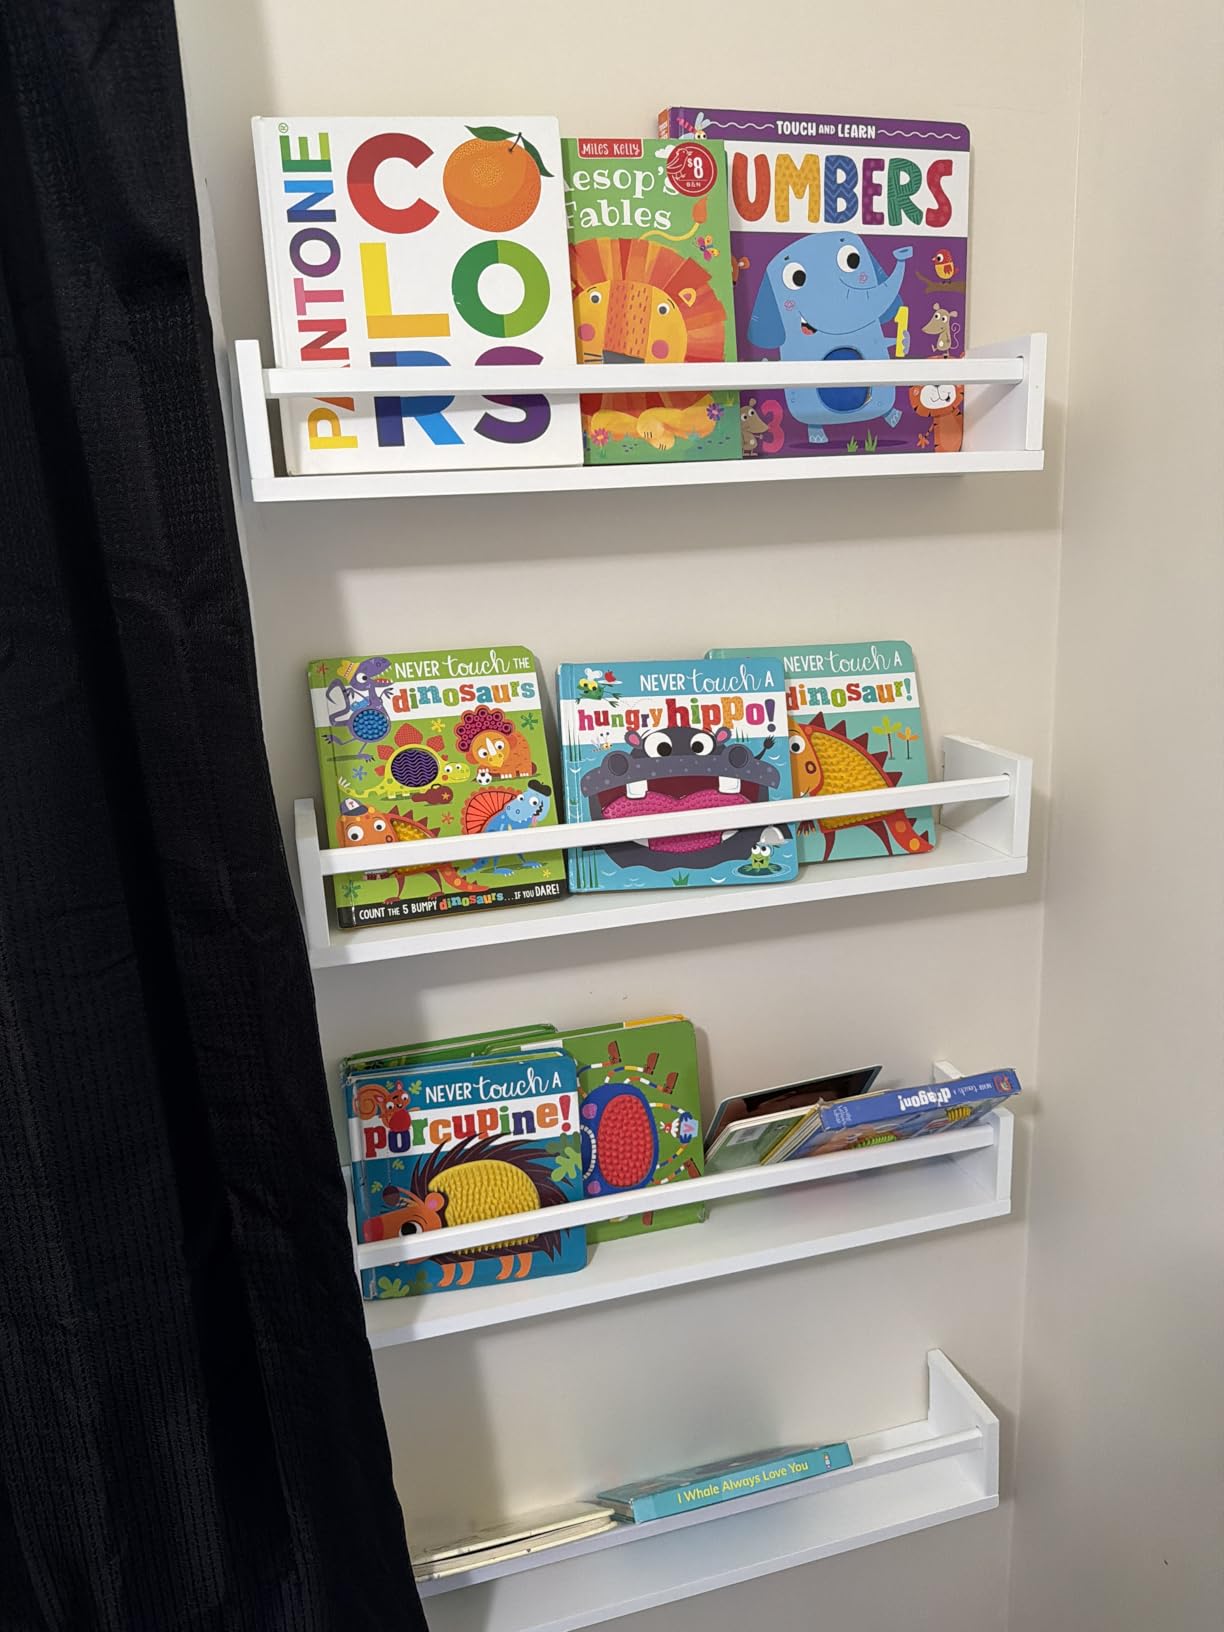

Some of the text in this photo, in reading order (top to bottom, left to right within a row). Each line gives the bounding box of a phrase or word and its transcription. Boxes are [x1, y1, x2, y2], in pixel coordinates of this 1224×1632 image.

[776, 120, 876, 139] TOUCH AND LEARN
[564, 166, 681, 199] esop's
[687, 156, 704, 179] $8
[394, 649, 531, 679] NEVER touch THE
[783, 645, 903, 673] NEVER touch A
[640, 663, 775, 693] NEVER touch A
[785, 677, 913, 711] dinosaur!
[391, 680, 536, 714] dinosaurs
[577, 695, 777, 733] hungry hippo!
[359, 906, 386, 921] COUNT
[387, 907, 401, 917] THE
[402, 904, 409, 915] 5
[411, 900, 438, 914] BUMPY
[523, 890, 535, 899] YOU
[535, 883, 560, 897] DARE!
[425, 1066, 562, 1104] NEVER touch A
[897, 1087, 952, 1112] dragon!
[363, 1094, 572, 1159] porcupine!
[676, 1461, 809, 1505] I Whale Always Love You
